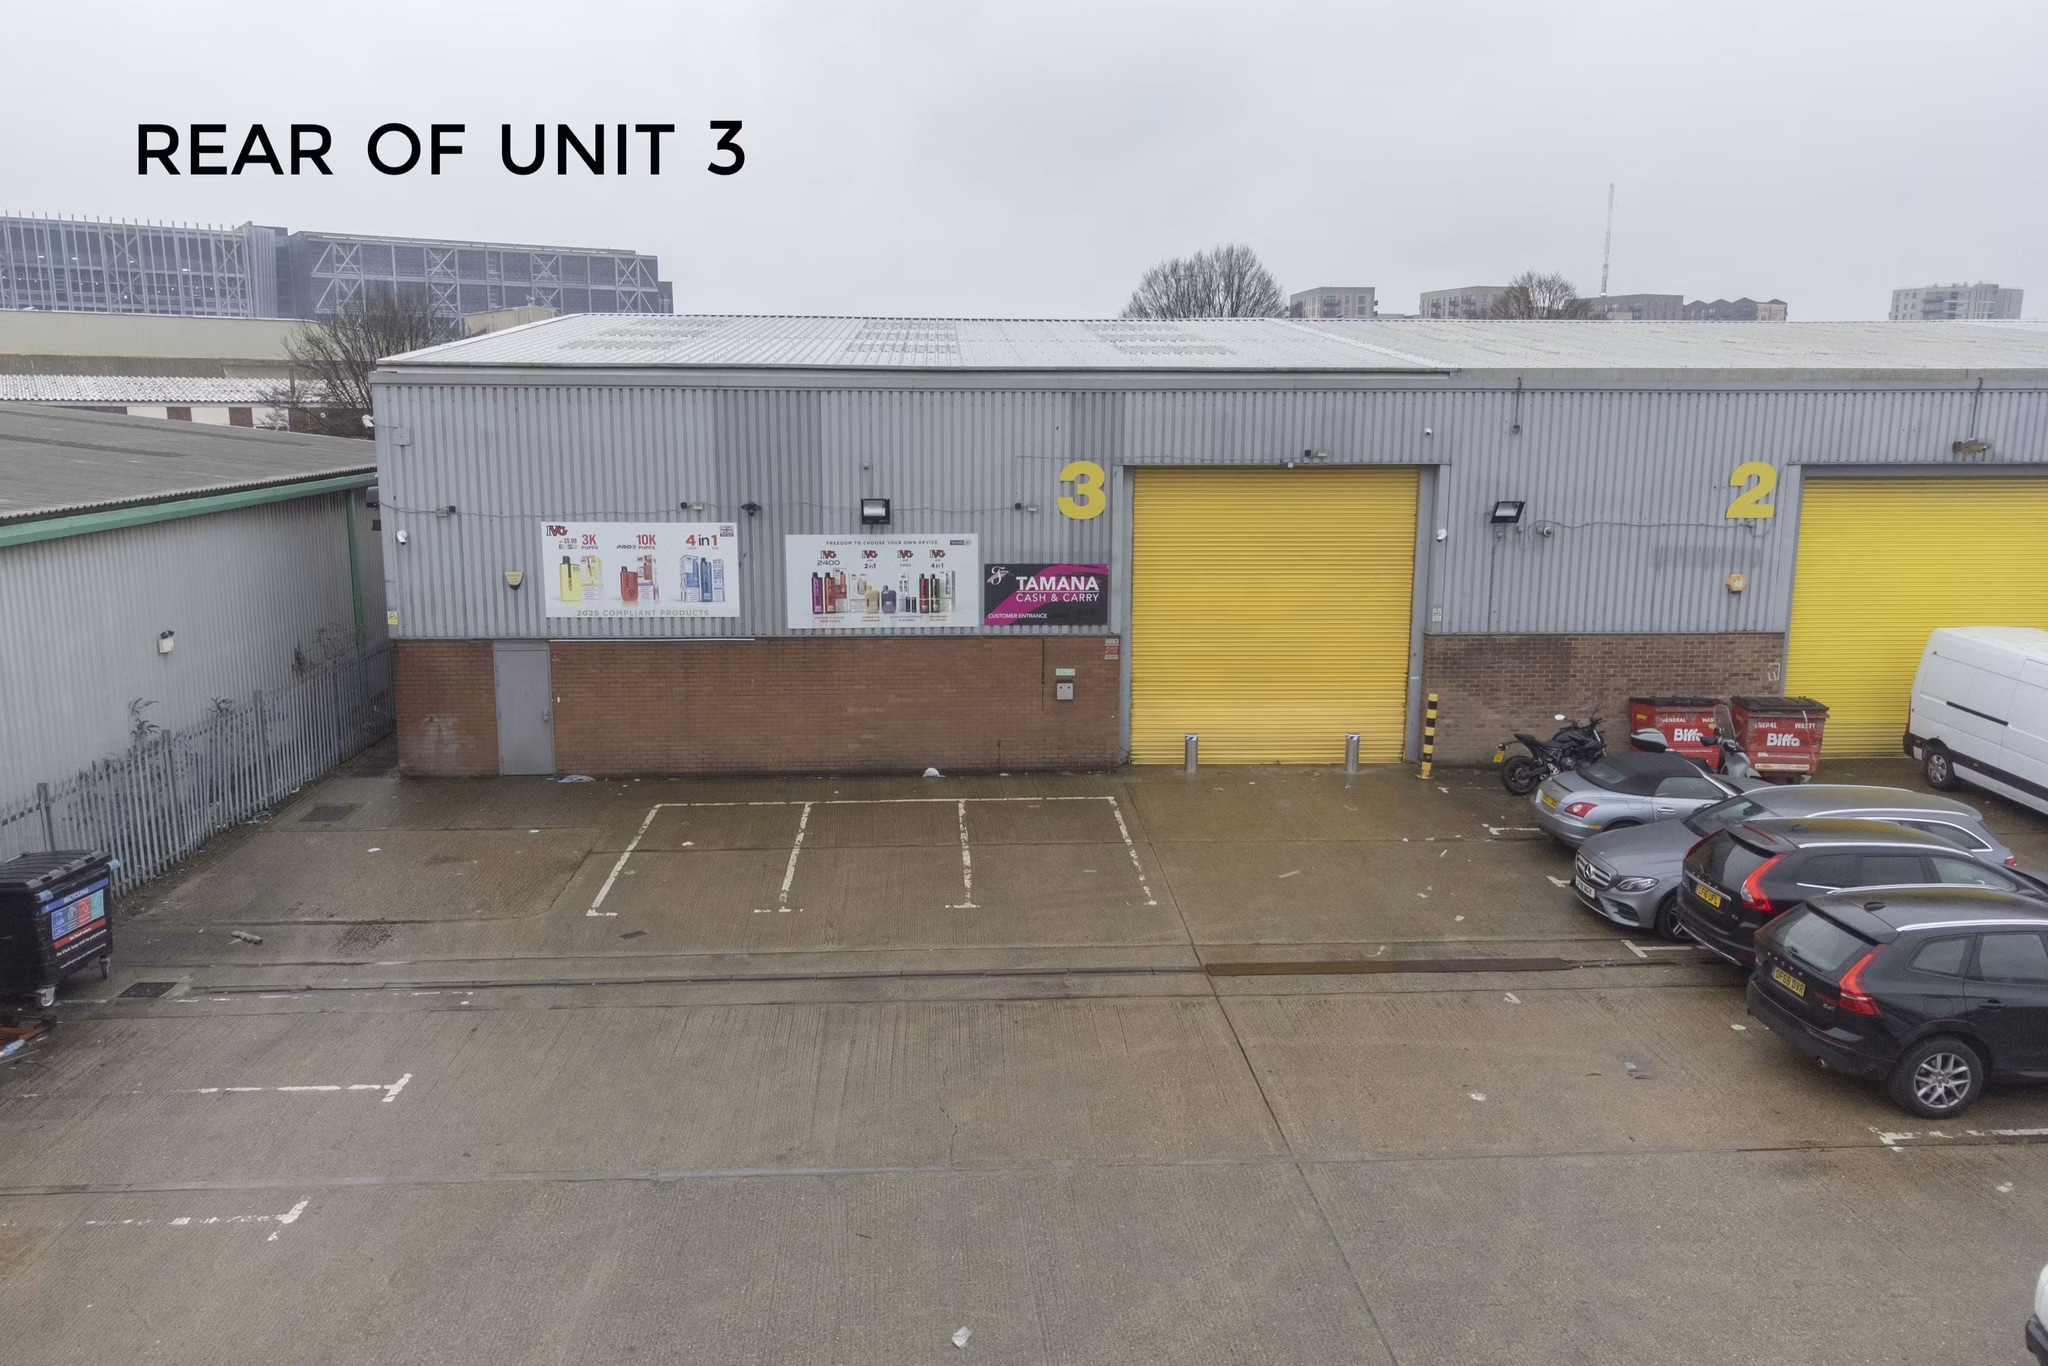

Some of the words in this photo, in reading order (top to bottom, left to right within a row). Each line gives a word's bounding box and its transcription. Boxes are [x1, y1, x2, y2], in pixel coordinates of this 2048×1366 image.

[1057, 460, 1106, 520] 3
[1725, 461, 1777, 519] 2
[582, 534, 597, 545] 3K
[636, 534, 656, 545] 10K
[686, 534, 696, 546] 4
[698, 534, 710, 546] in
[711, 534, 718, 546] 1
[1016, 576, 1099, 591] TAMANA
[1016, 593, 1046, 602] CASH
[1051, 593, 1058, 602] &
[1063, 593, 1099, 602] CARRY
[1767, 733, 1800, 747] Biffa
[64, 888, 88, 903] RECYCLING
